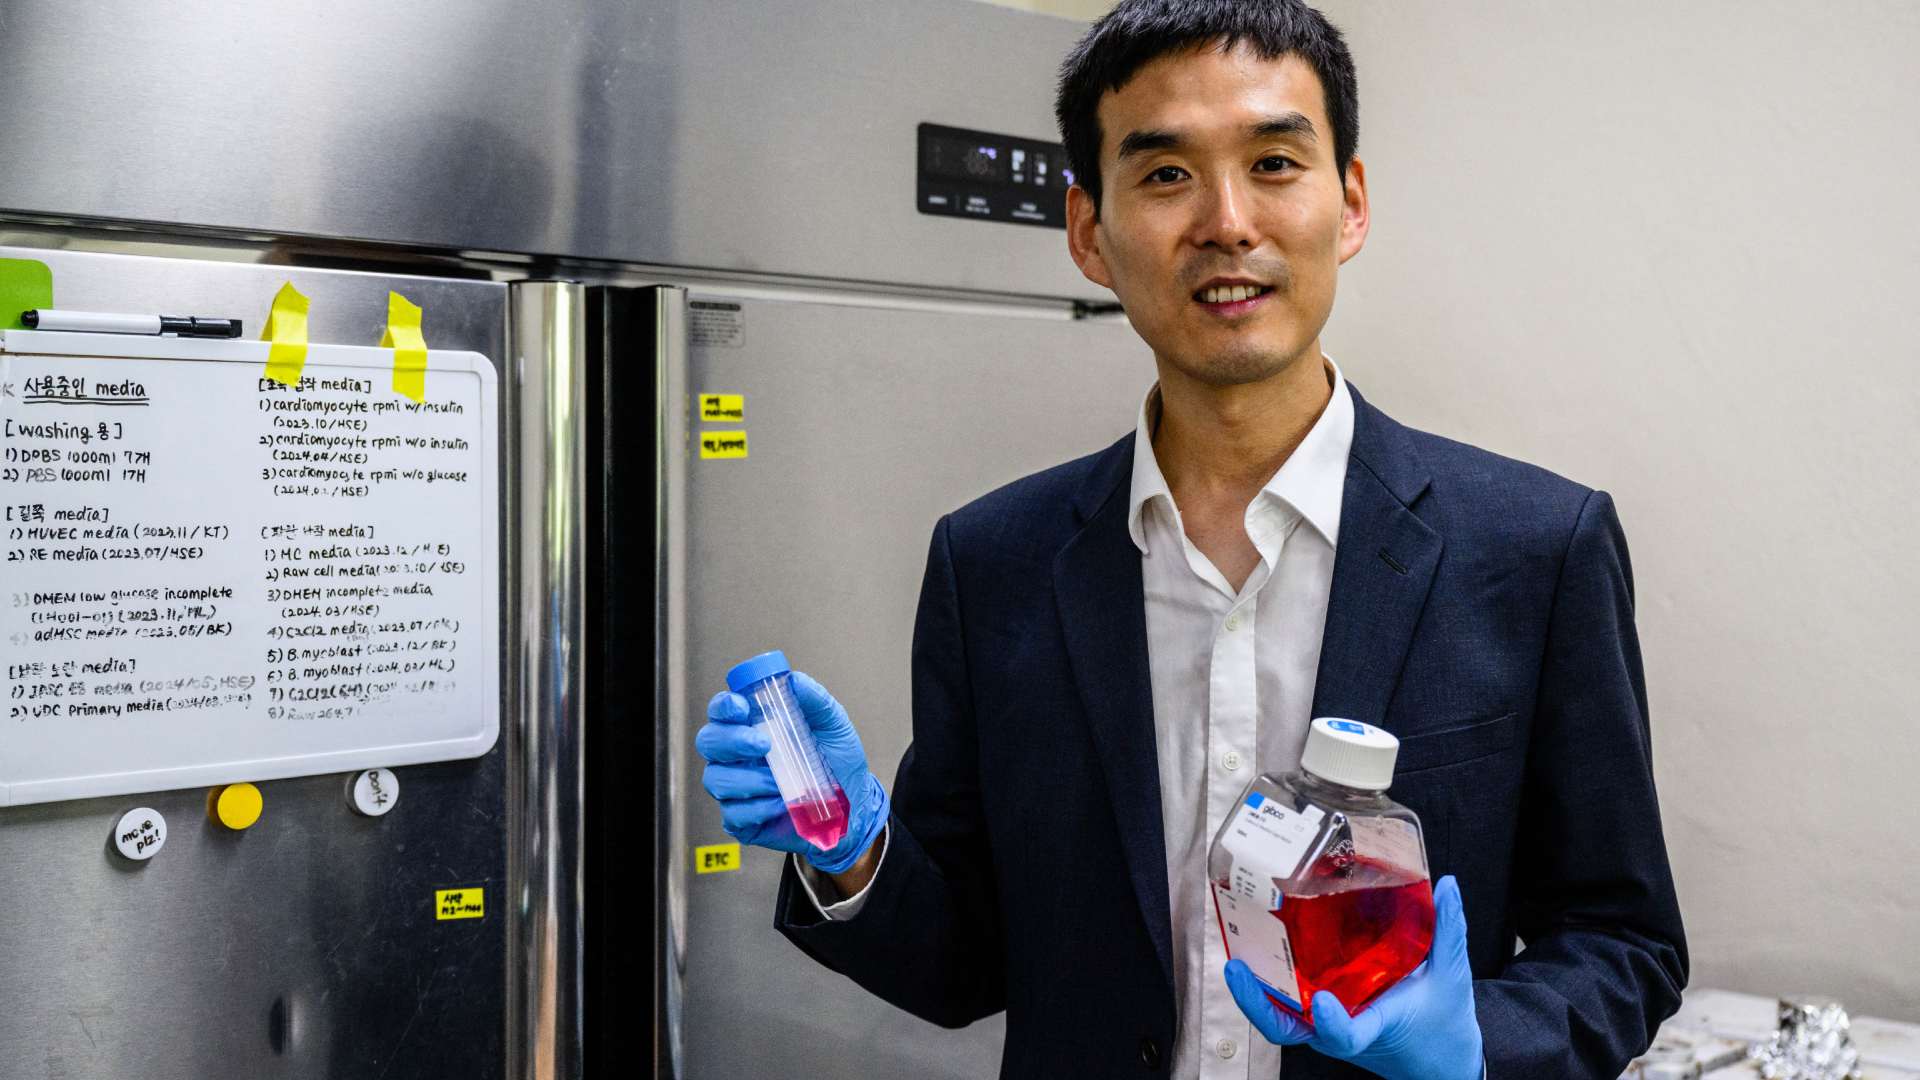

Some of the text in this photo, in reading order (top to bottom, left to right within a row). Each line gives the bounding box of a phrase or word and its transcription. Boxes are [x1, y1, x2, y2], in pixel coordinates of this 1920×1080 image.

[24, 375, 146, 397] 사용중인 media
[321, 376, 371, 394] media]
[373, 401, 400, 415] rpmi
[372, 436, 400, 450] rpmi
[405, 437, 426, 448] w/o
[26, 467, 59, 483] PBS
[370, 468, 397, 484] rpmi
[402, 469, 424, 480] w/o
[426, 469, 467, 483] glucose
[54, 505, 109, 523] media]
[28, 528, 77, 540] HUVEC
[83, 525, 130, 539] media
[328, 523, 374, 539] media]
[52, 545, 98, 561] media
[309, 544, 352, 560] media
[314, 564, 334, 577] cell
[338, 564, 377, 577] media
[80, 592, 106, 602] low
[164, 586, 232, 601] incomplete
[393, 582, 433, 596] media
[82, 657, 136, 674] media]
[127, 697, 164, 713] media
[704, 852, 729, 867] ETC
